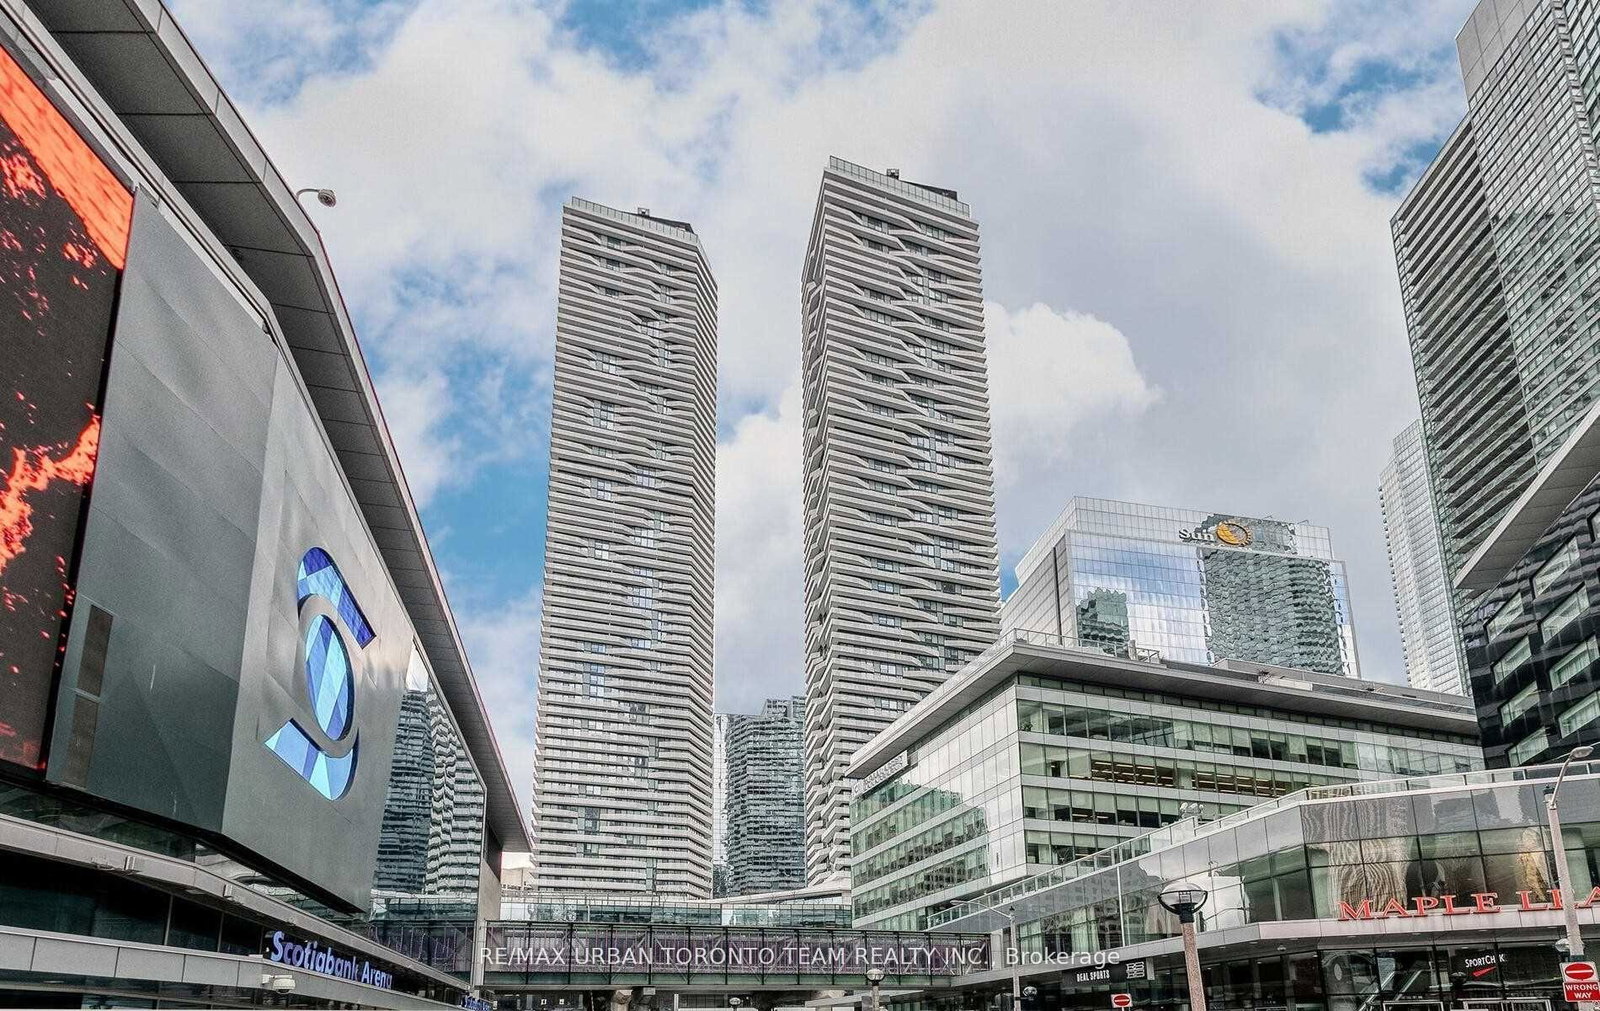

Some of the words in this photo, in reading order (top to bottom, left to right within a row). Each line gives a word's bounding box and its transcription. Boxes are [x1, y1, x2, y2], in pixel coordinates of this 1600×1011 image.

[1179, 527, 1215, 541] Sun
[1338, 893, 1501, 921] MAPLE
[270, 930, 360, 981] Scotiabank
[361, 961, 393, 990] Arena
[1465, 954, 1505, 968] SPORTCHK
[1077, 973, 1089, 982] REAL
[1090, 970, 1110, 981] SPORTS
